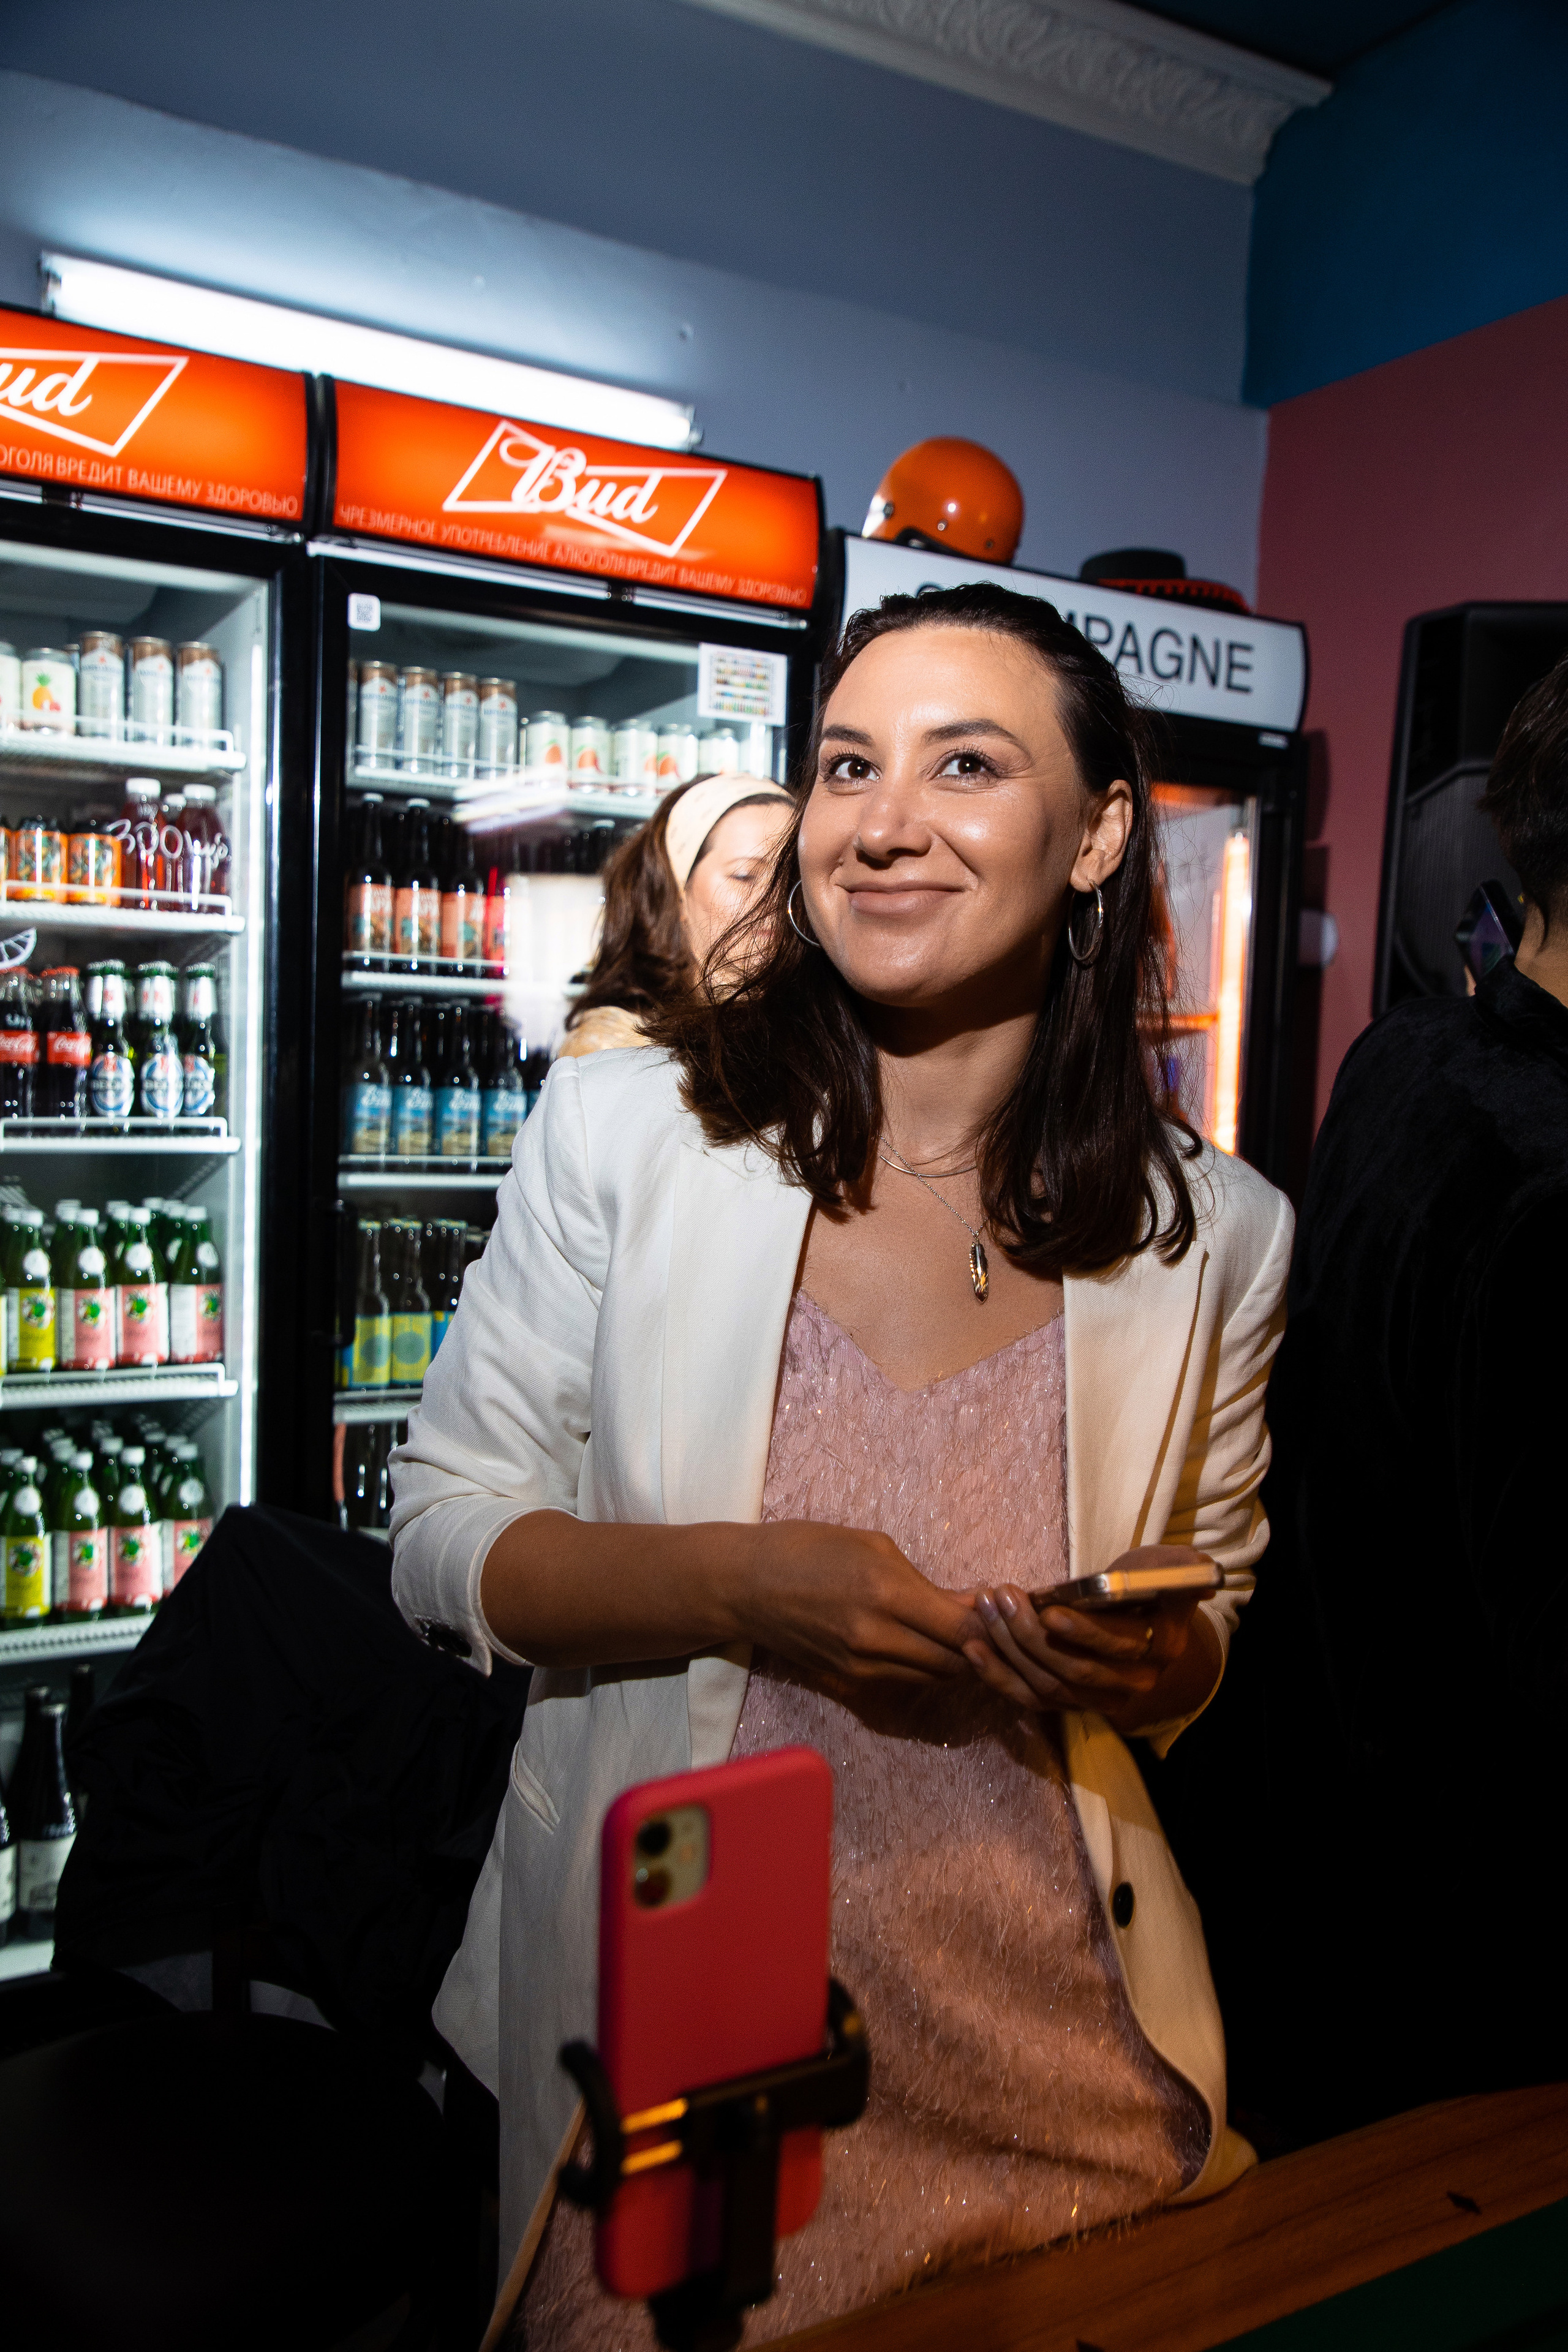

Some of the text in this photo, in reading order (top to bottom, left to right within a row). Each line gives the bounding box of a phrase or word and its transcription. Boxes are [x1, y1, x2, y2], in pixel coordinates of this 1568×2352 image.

[56, 455, 124, 486] ВРЕДИТ
[127, 467, 203, 500] ВАШЕМУ
[206, 481, 299, 517] ЗДОРОВЬЮ
[499, 435, 663, 524] Bud
[339, 504, 435, 540] ЧРЕЗМЕРНОЕ
